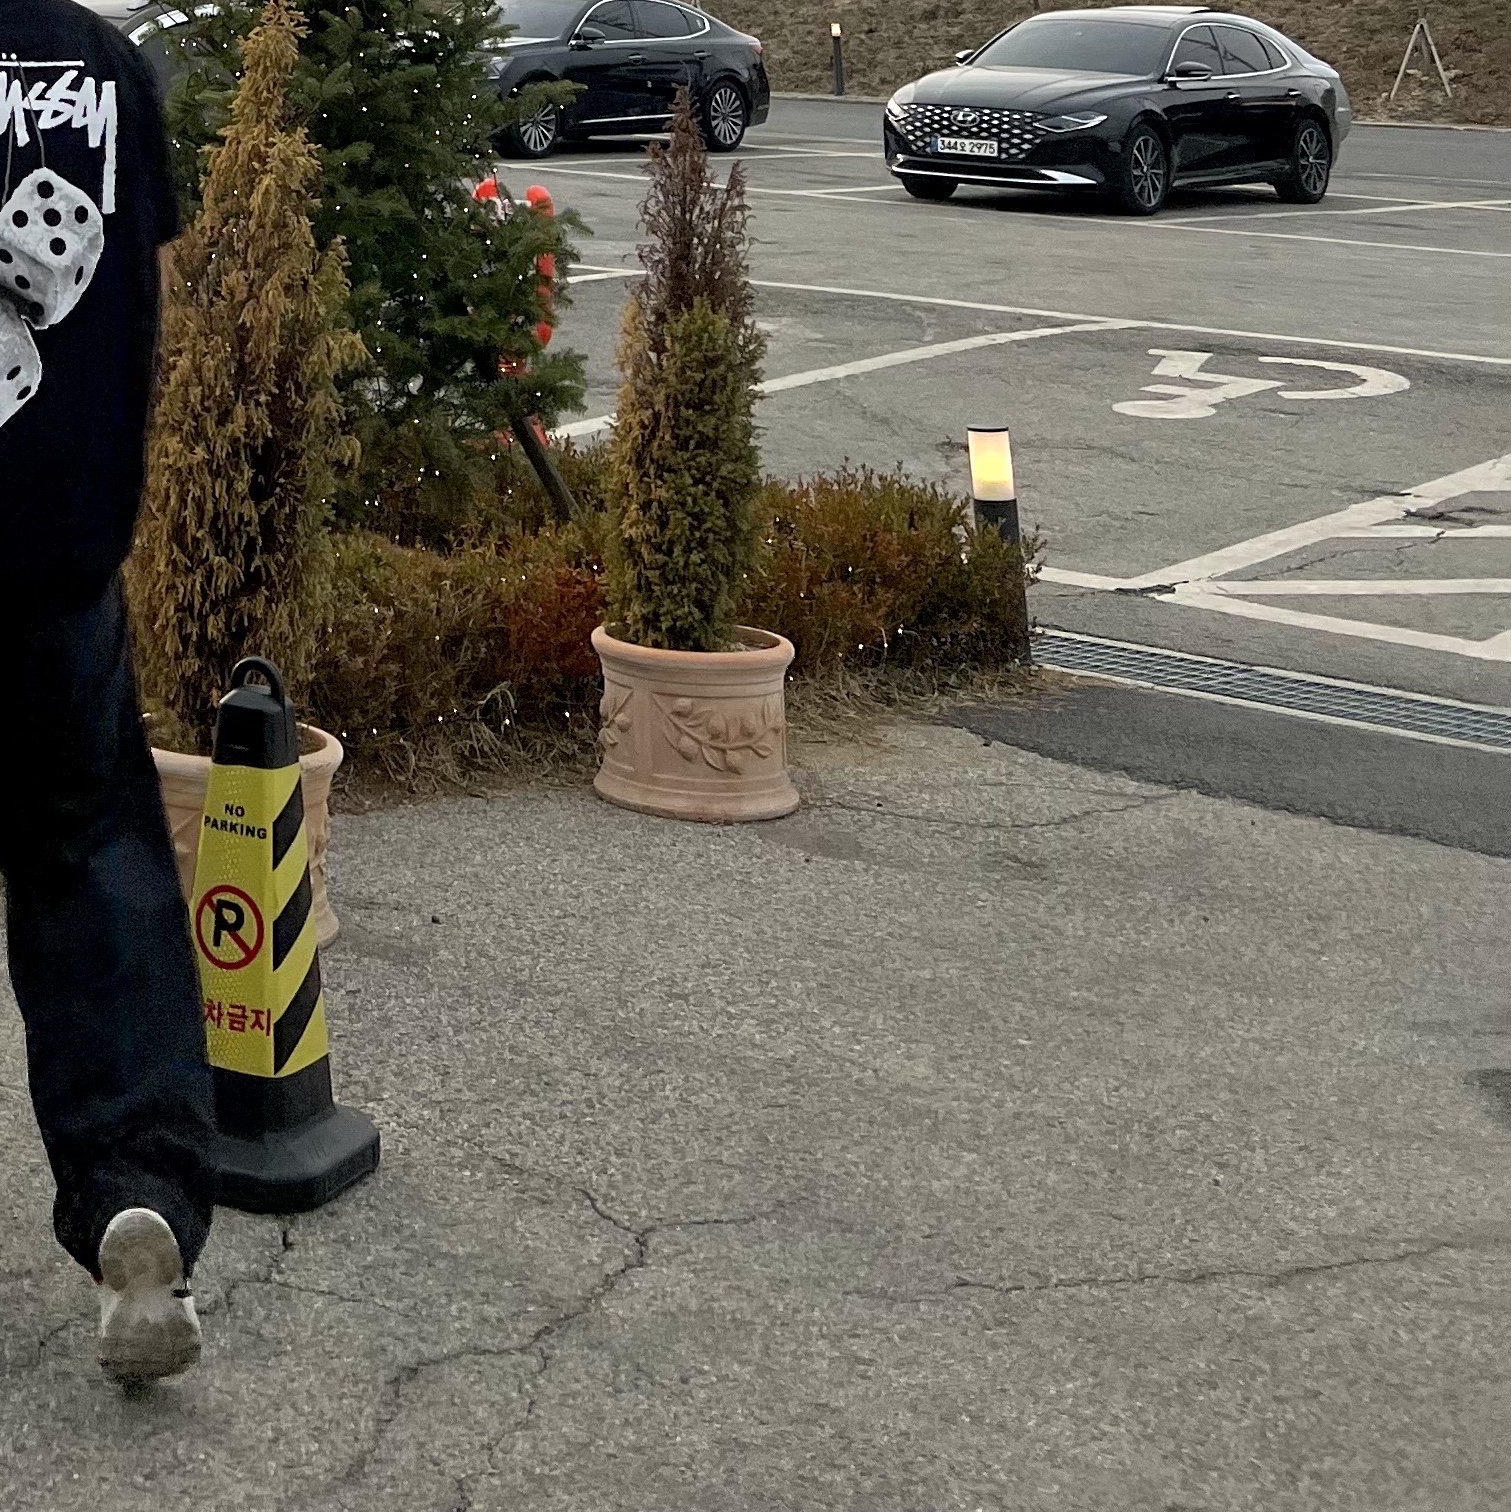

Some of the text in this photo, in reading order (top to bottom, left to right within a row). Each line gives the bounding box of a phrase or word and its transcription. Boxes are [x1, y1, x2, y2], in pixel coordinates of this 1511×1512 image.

[968, 141, 996, 155] 2975
[224, 803, 245, 817] NO
[204, 815, 267, 839] PARKING
[213, 898, 245, 947] P
[203, 998, 271, 1037] 차금지
